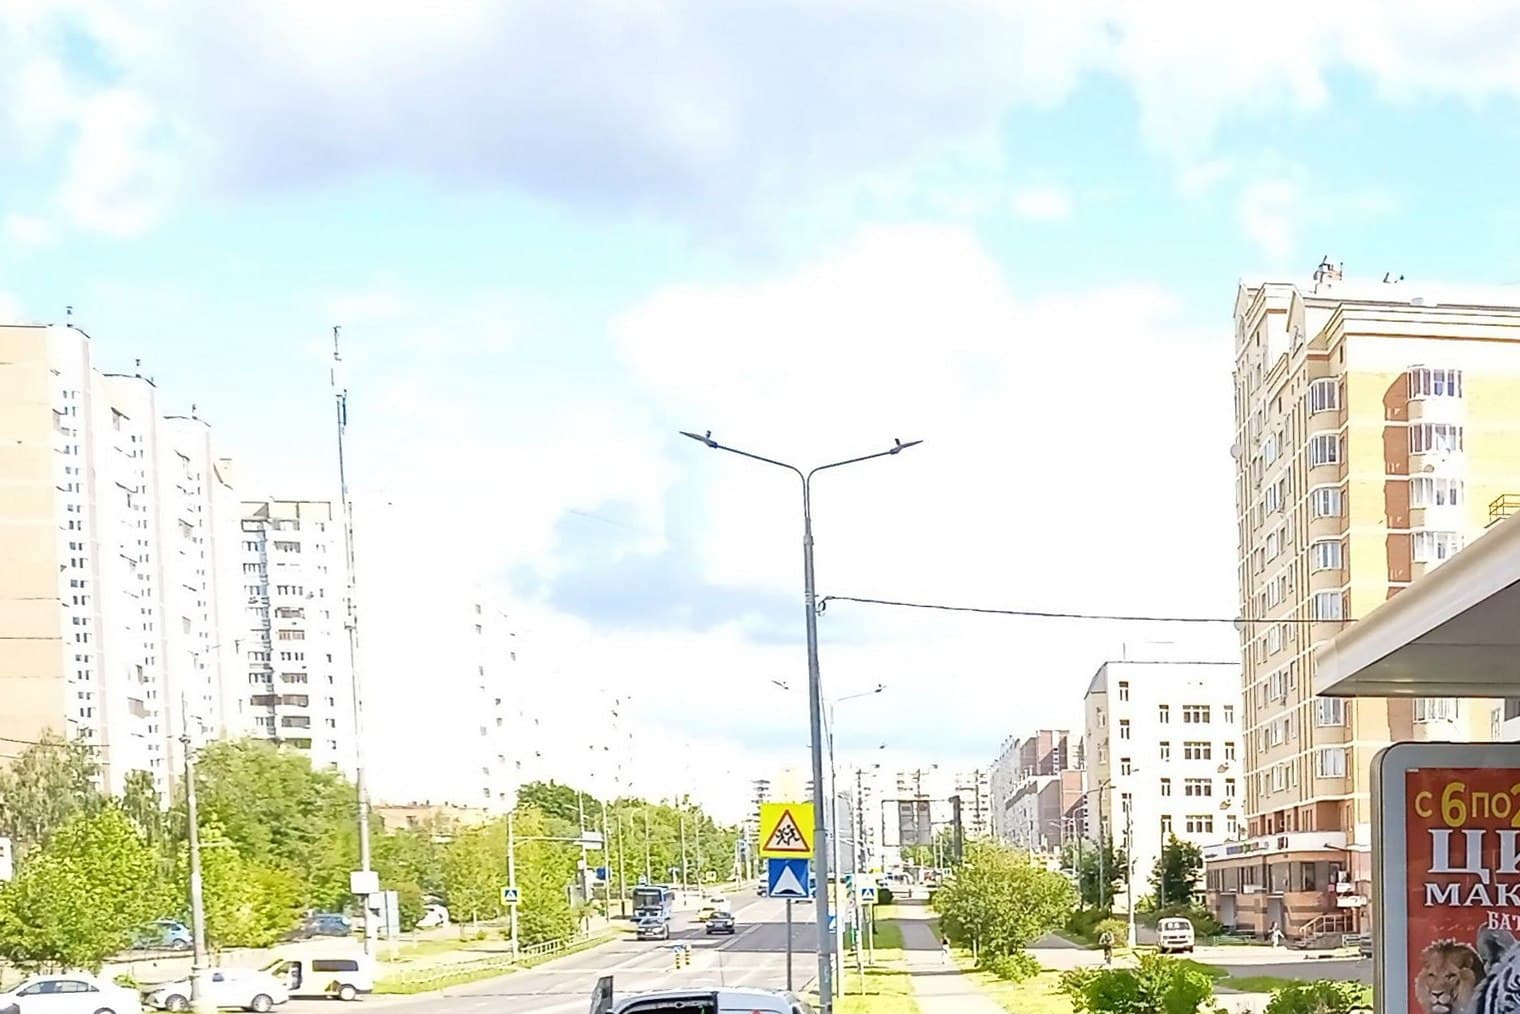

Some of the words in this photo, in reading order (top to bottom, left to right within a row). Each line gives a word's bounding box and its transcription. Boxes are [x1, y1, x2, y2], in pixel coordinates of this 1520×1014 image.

[1415, 791, 1433, 818] С
[1441, 782, 1467, 827] 6
[1471, 791, 1511, 819] ПО
